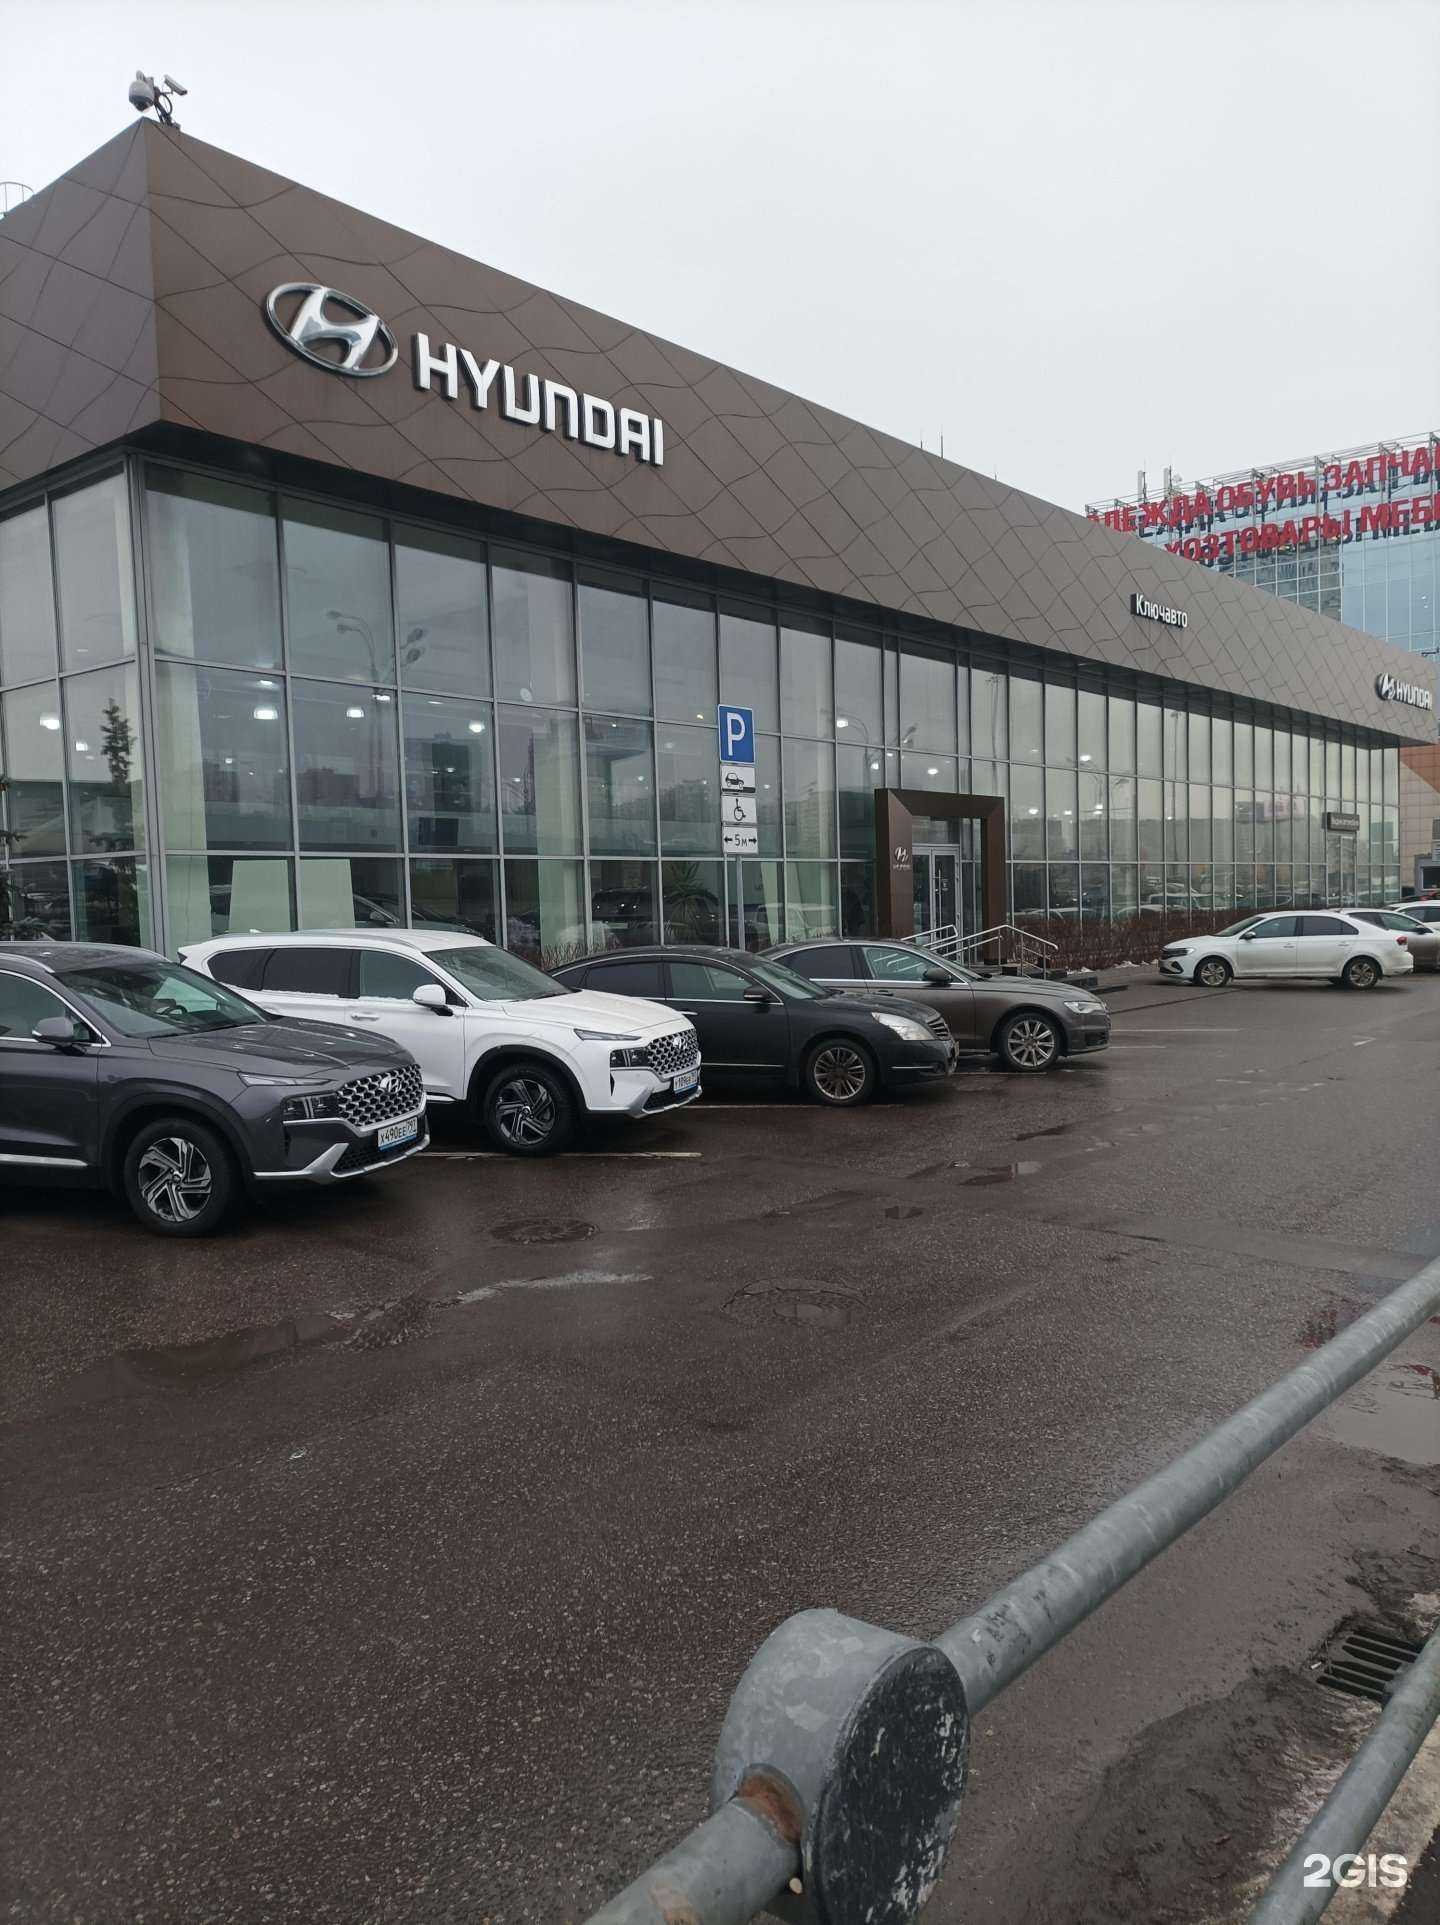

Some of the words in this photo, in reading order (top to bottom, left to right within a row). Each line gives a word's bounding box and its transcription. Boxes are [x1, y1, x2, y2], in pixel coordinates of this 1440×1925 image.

[413, 332, 664, 466] HYUNDAI
[1087, 490, 1213, 532] ДЕЖДА
[1216, 472, 1316, 511] ОБУВЬ
[1135, 593, 1188, 628] Ключавто
[726, 712, 746, 756] P
